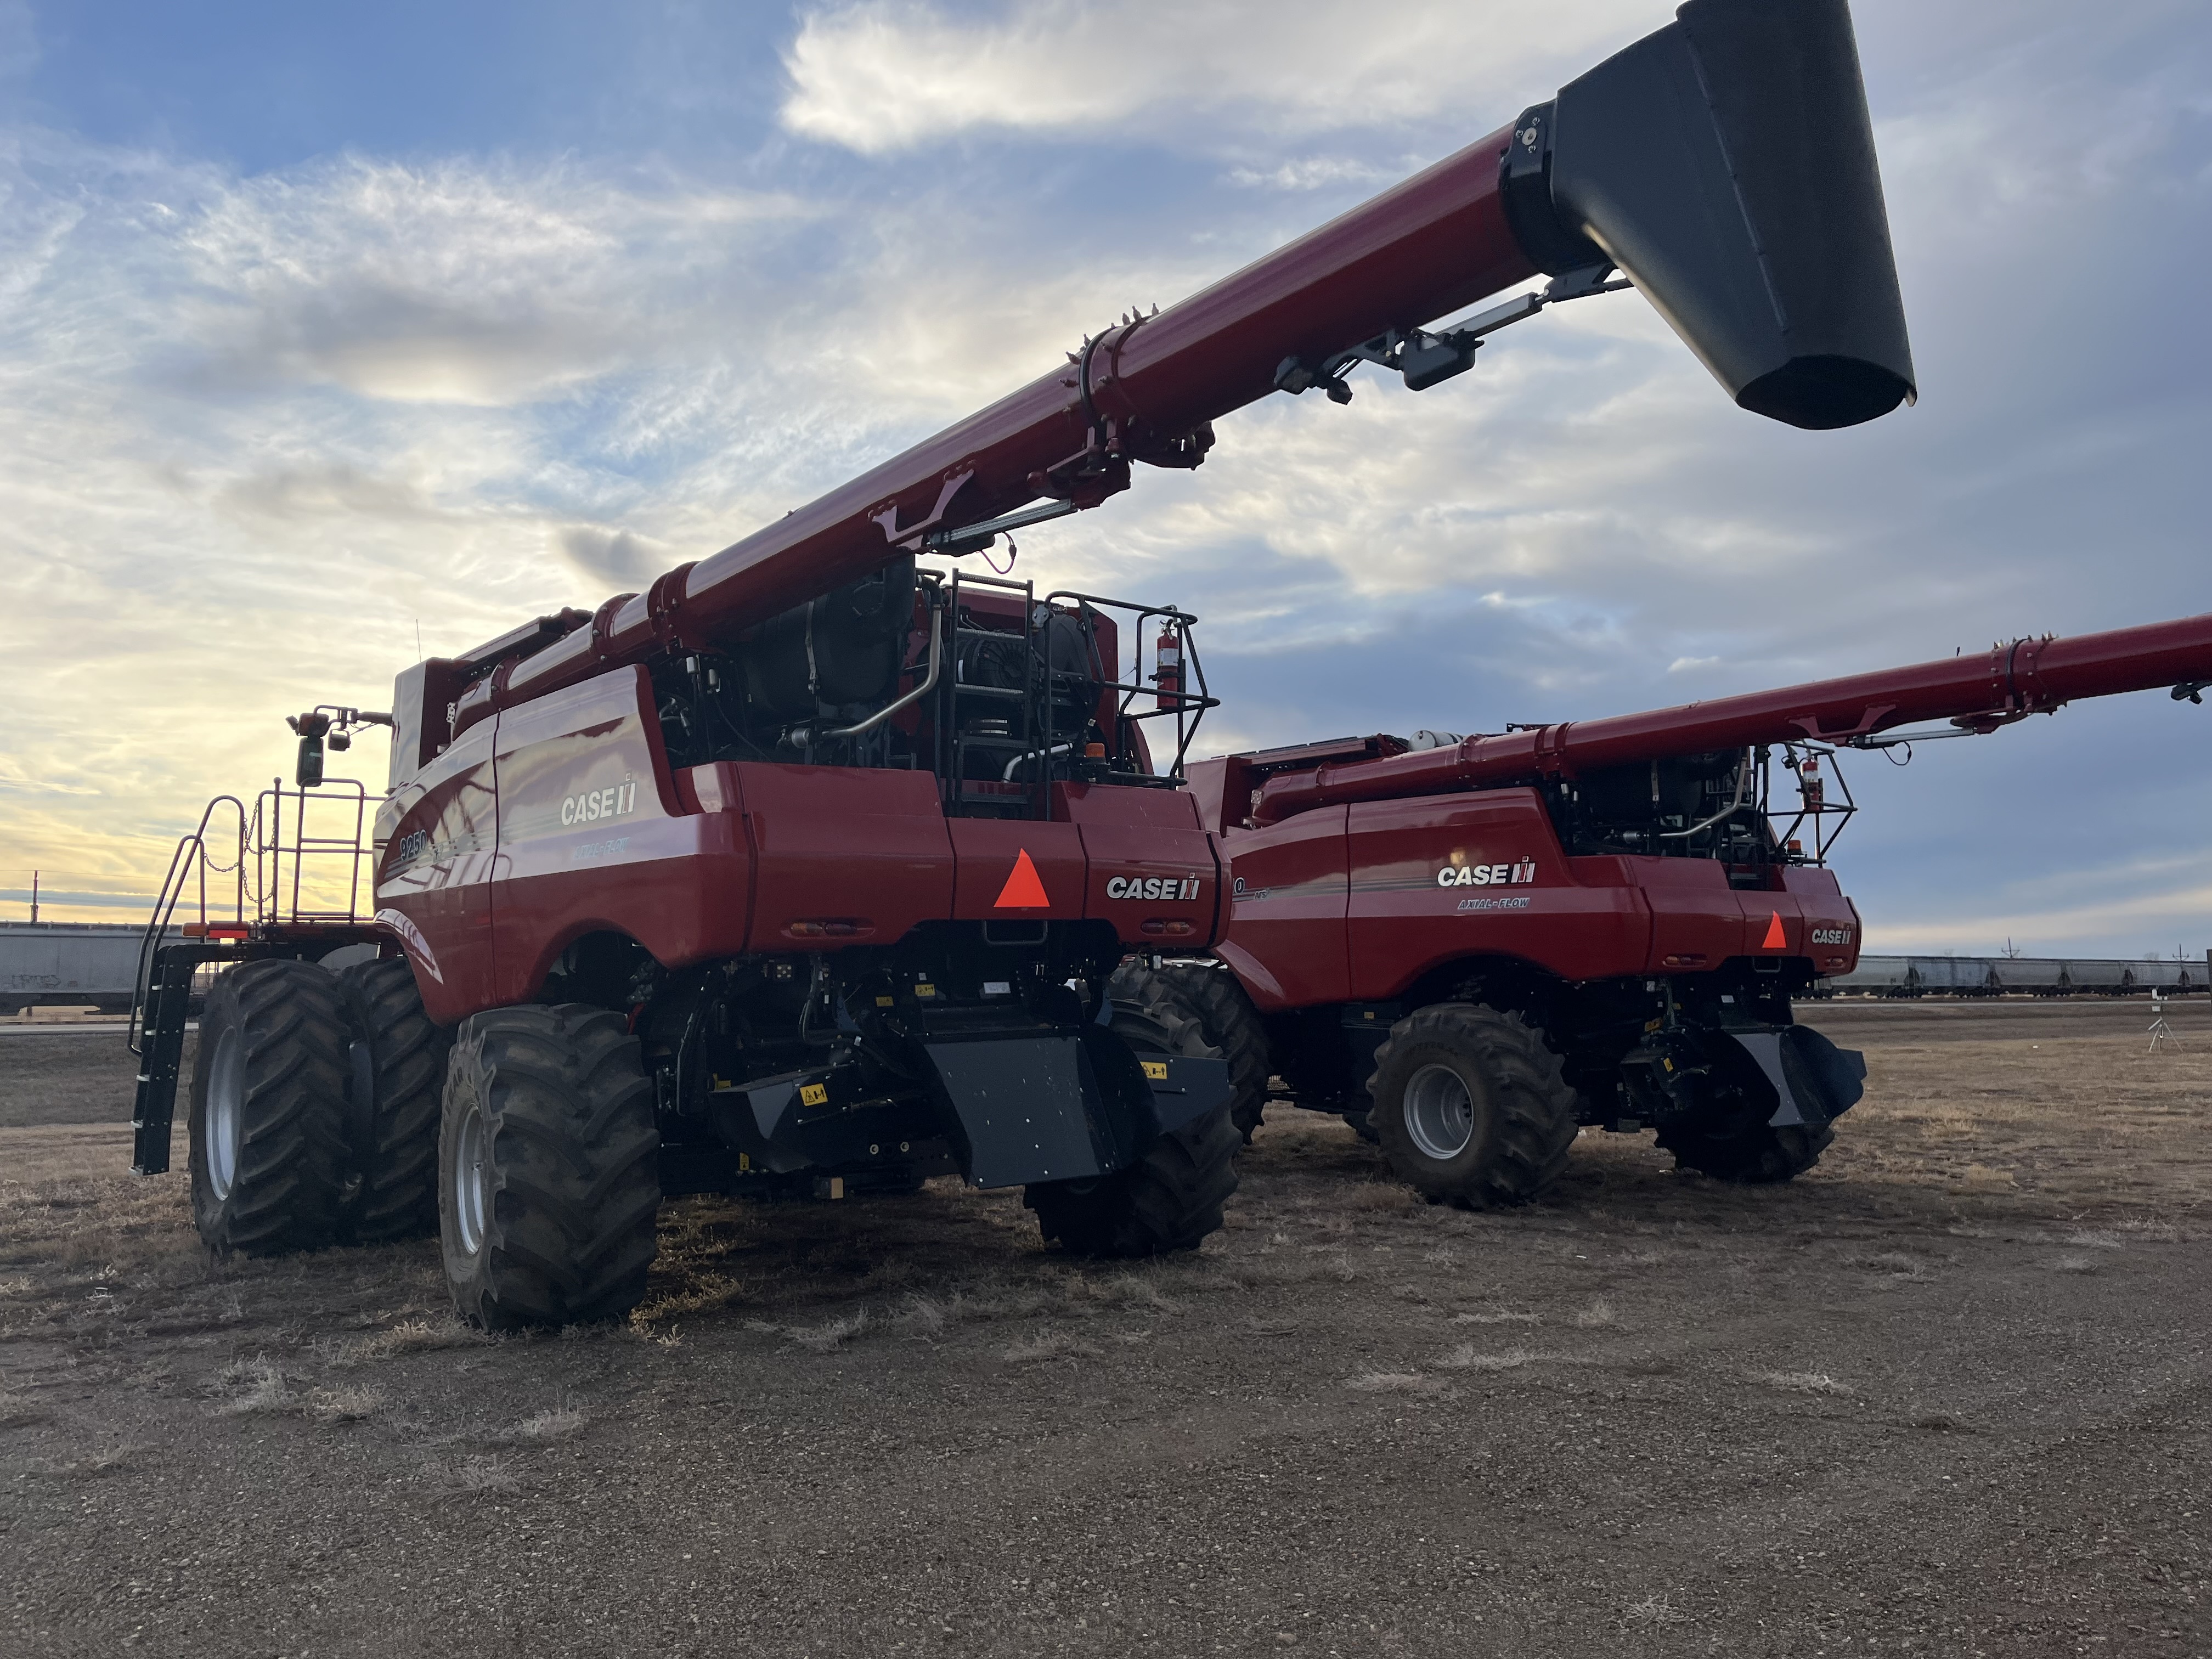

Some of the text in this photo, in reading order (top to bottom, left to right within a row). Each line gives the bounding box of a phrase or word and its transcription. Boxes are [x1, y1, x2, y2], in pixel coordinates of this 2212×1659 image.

[561, 787, 615, 826] CASE
[400, 829, 427, 861] 9250
[1437, 864, 1509, 887] CASE
[1106, 876, 1178, 900] CASE
[1457, 897, 1531, 910] AXIAL-FLOW
[1812, 928, 1842, 944] CASE
